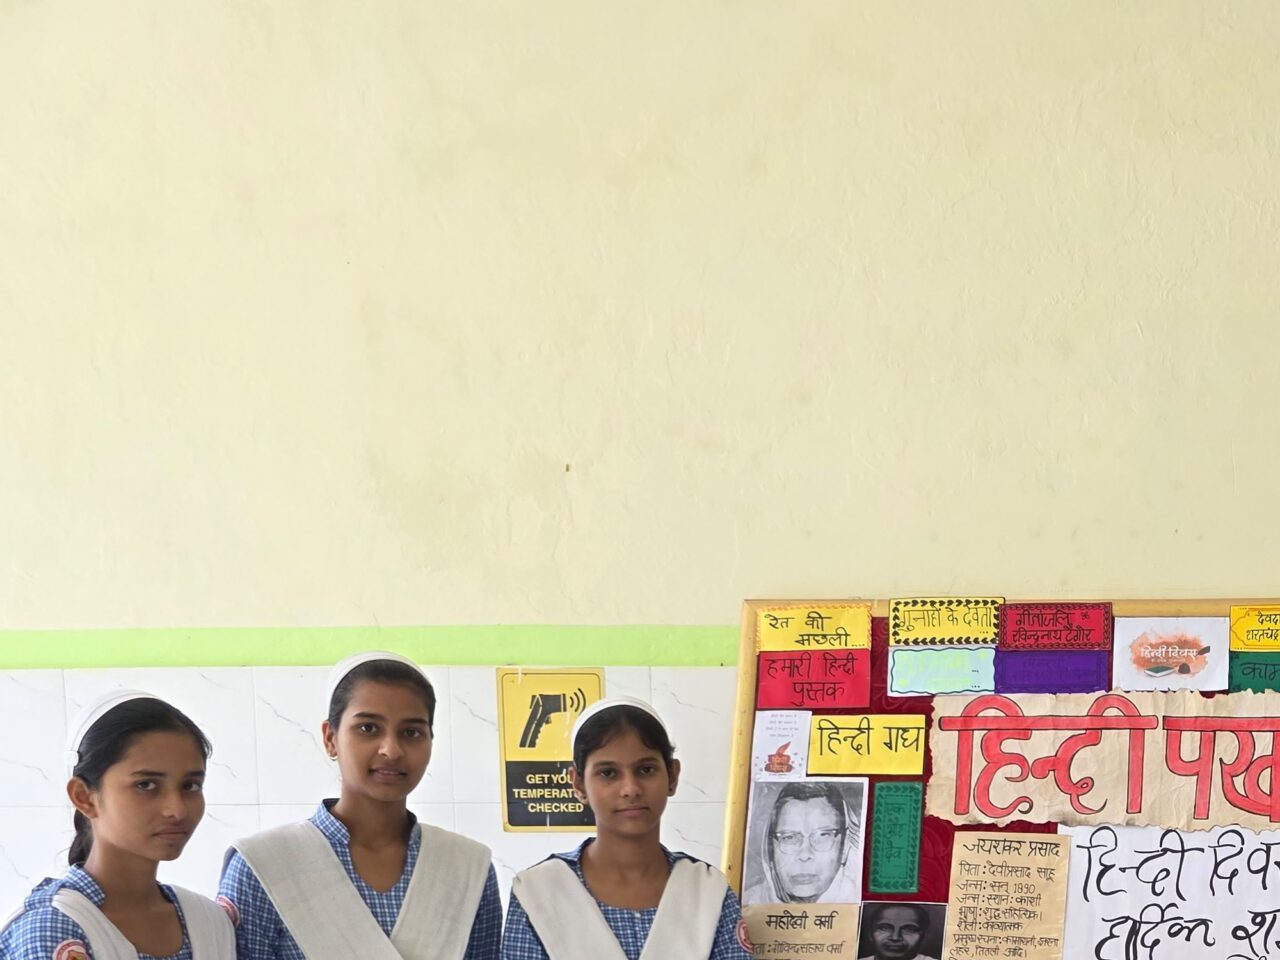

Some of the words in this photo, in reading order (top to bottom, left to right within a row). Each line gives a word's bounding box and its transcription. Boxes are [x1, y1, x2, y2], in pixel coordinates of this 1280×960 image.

[764, 613, 795, 629] रेत
[805, 611, 832, 631] की
[945, 607, 959, 626] के
[765, 652, 811, 678] हमारी
[823, 652, 858, 677] हिन्दी
[792, 682, 845, 706] पुस्तक
[816, 717, 874, 756] हिन्दी
[938, 693, 1160, 819] हिन्दी
[526, 774, 550, 784] GET
[551, 774, 573, 784] YOU
[513, 788, 575, 799] TEMPERAT
[527, 802, 584, 813] CHECKED
[963, 838, 1027, 856] जयशंकर
[1028, 840, 1061, 857] प्रसाद
[1076, 825, 1205, 902] हिन्दी
[1013, 883, 1036, 894] 1890
